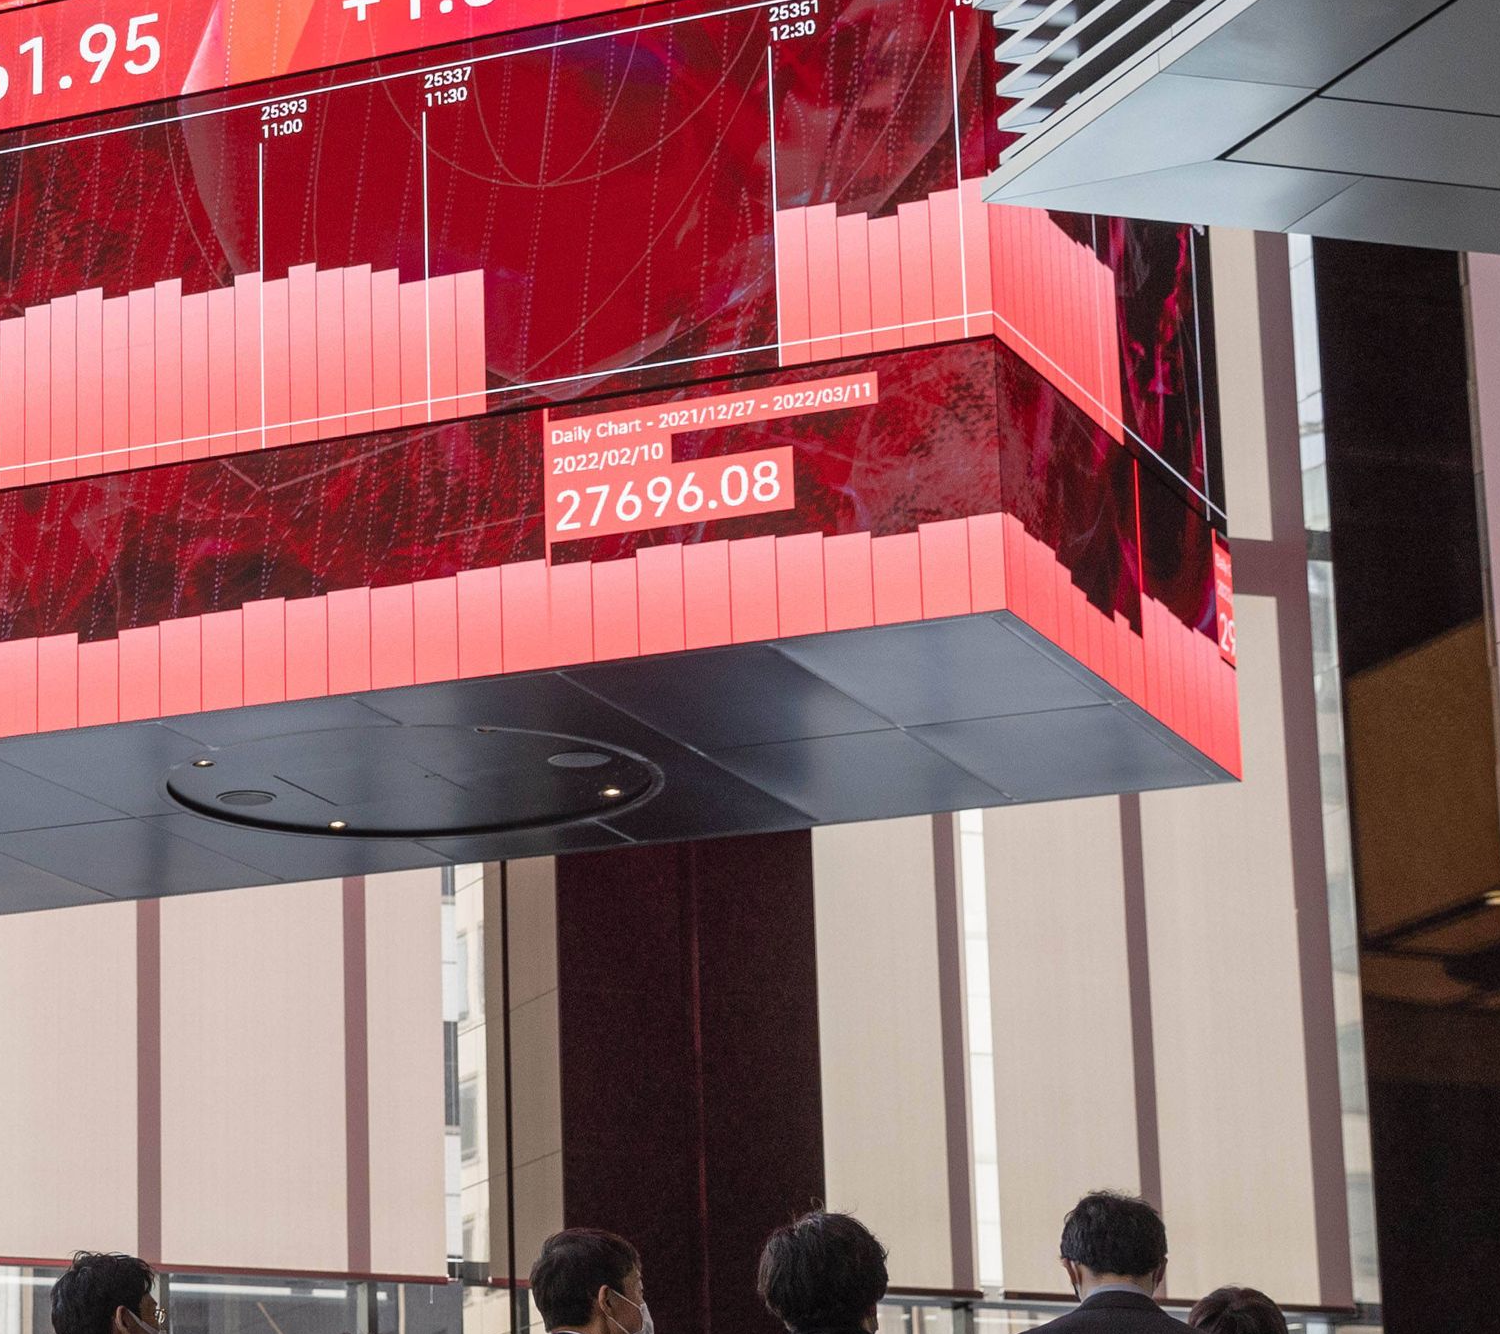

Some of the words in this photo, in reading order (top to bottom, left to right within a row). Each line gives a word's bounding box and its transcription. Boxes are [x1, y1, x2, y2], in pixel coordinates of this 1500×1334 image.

[768, 0, 819, 23] 25351
[769, 19, 817, 41] 12:30
[424, 67, 473, 89] 25337
[425, 86, 468, 107] 11:30
[260, 99, 308, 121] 25393
[261, 119, 303, 139] 11:00
[550, 419, 592, 446] Daily
[595, 414, 642, 439] Chart
[658, 398, 755, 431] 2021/12/27
[773, 380, 873, 413] 2022/03/11
[552, 441, 664, 475] 2022/02/10
[555, 461, 782, 533] 27696.08
